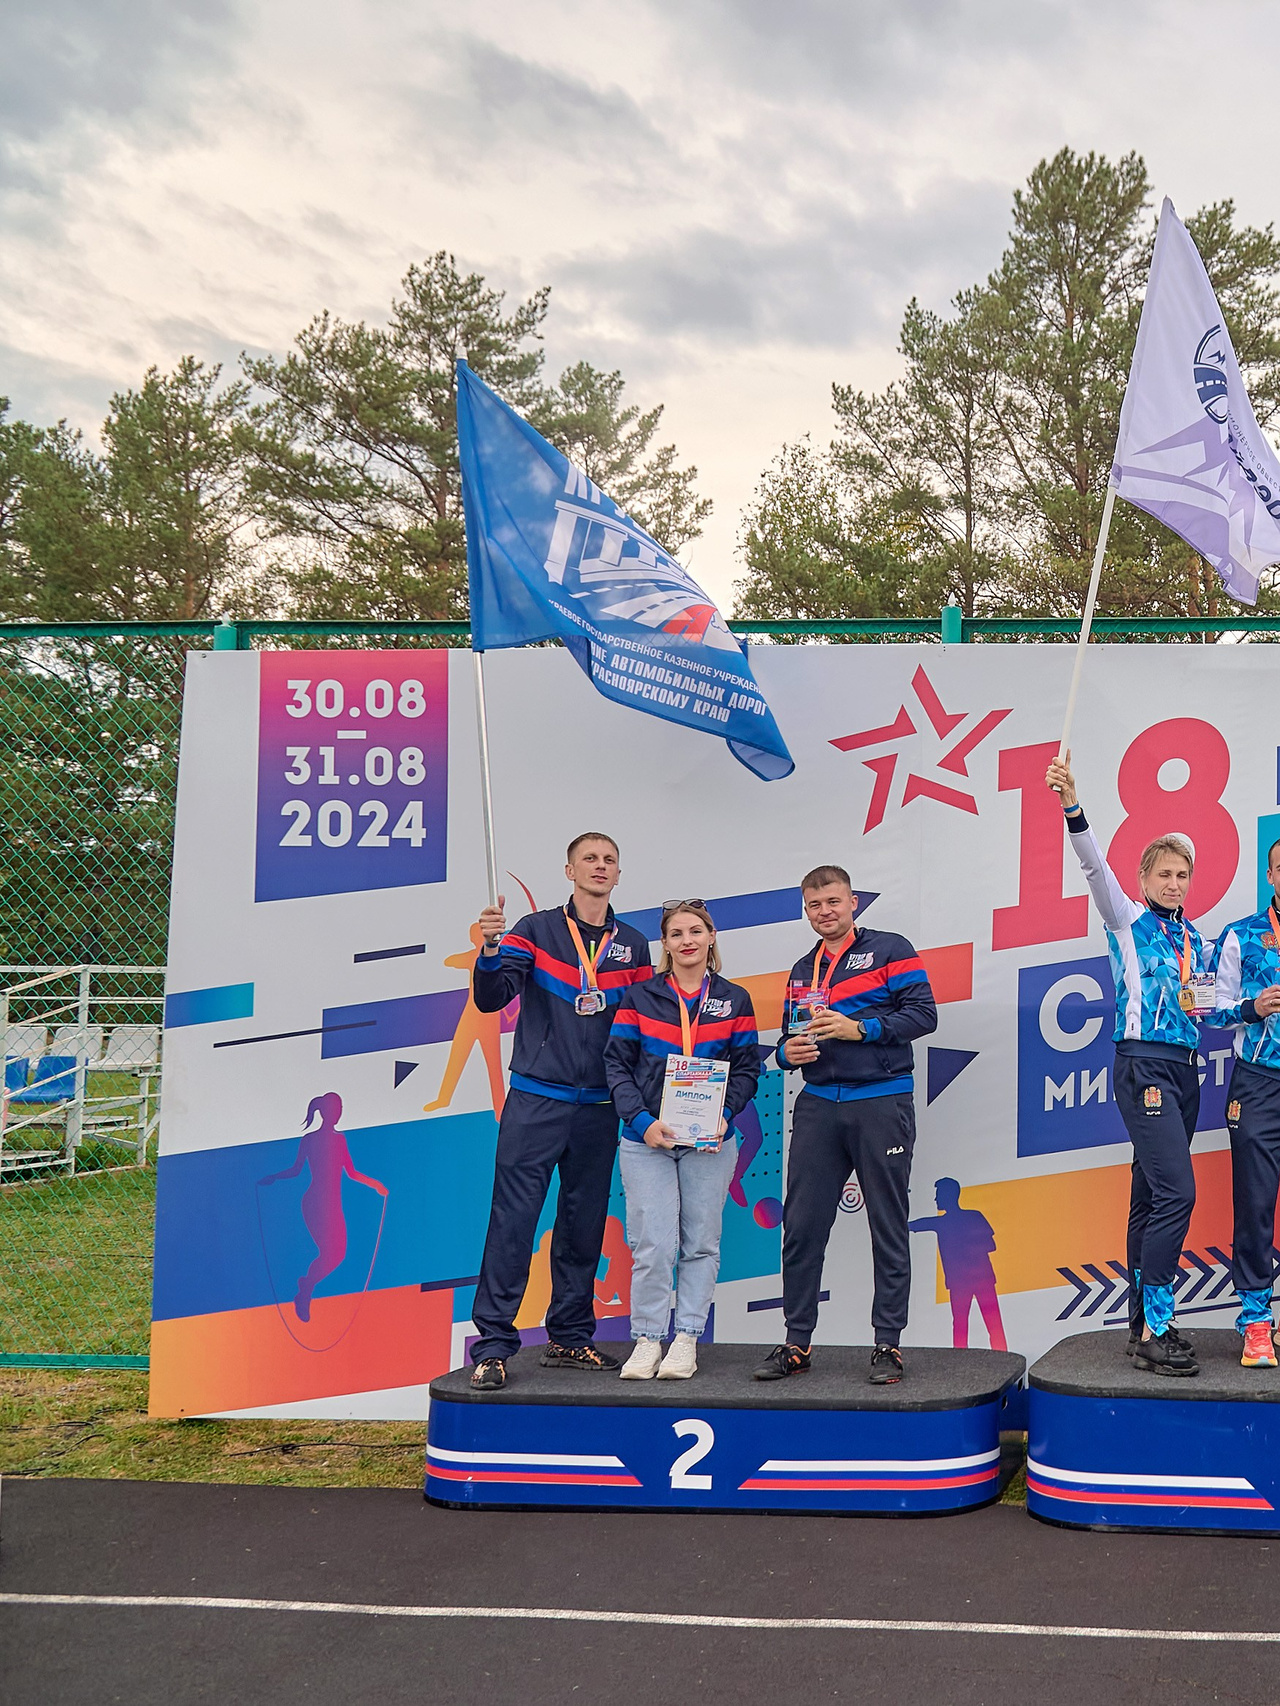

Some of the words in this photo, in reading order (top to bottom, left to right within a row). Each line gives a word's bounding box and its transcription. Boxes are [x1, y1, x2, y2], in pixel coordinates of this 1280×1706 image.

[581, 620, 663, 660] ГОСУДАРСТВЕННОЕ
[663, 652, 713, 677] КАЗЕННОЕ
[712, 668, 761, 694] УЧРЕЖДЕН
[285, 678, 427, 719] 30.08
[591, 660, 690, 709] РАСНОЯРСКОМУ
[692, 698, 731, 723] КРАЮ
[610, 653, 726, 703] АВТОМОБИЛЬНЫХ
[727, 691, 768, 717] ДОРОГ
[284, 746, 427, 786] 31.08
[278, 799, 427, 848] 2024
[992, 717, 1240, 951] 18
[675, 1060, 688, 1071] 18
[674, 1090, 712, 1101] ДИПЛОМ
[886, 1145, 905, 1156] FILA
[669, 1418, 716, 1490] 2
